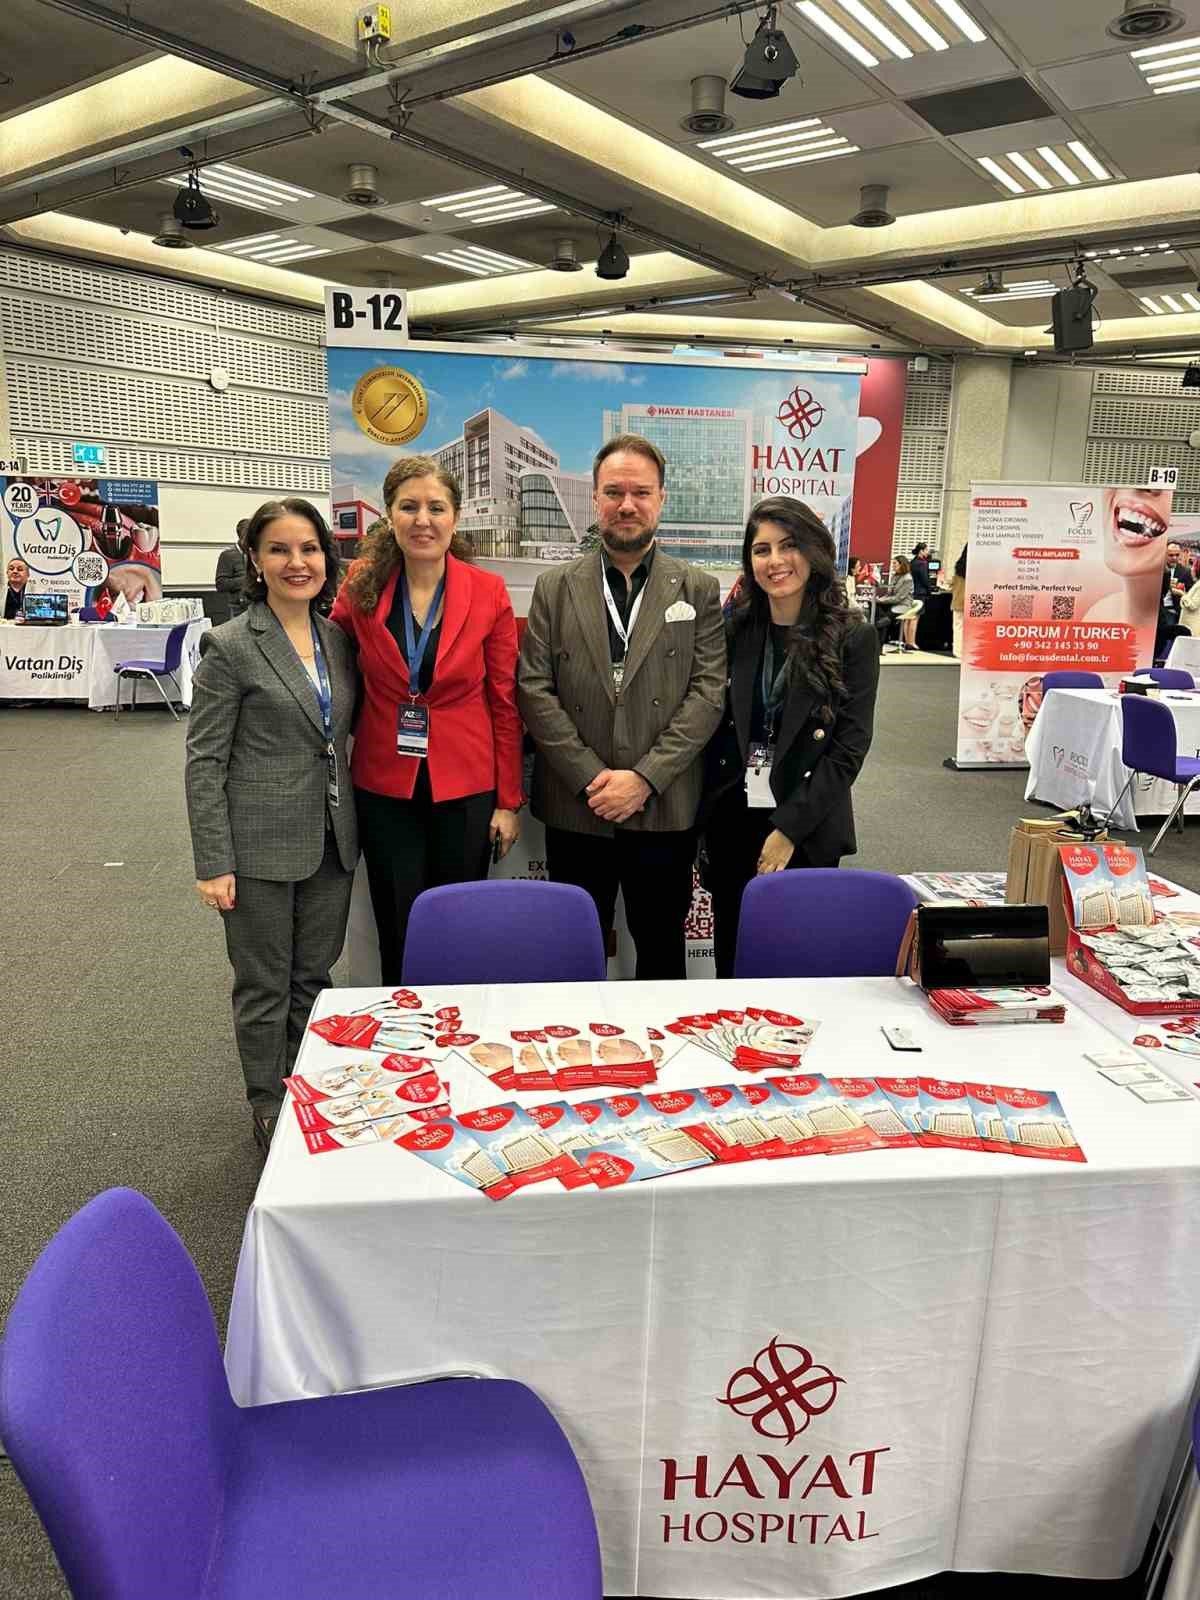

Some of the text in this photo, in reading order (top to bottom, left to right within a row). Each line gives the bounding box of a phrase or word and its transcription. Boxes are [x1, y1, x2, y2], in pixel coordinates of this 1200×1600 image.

[332, 291, 402, 331] B-12
[658, 408, 685, 416] HAYAT
[0, 461, 19, 471] C-14
[752, 445, 845, 473] HAYAT
[1151, 469, 1176, 484] B-19
[11, 487, 31, 502] 20
[752, 477, 841, 497] HOSPITAL
[23, 543, 77, 557] Vatan Diş
[996, 625, 1131, 640] BODRUM / TURKEY
[1013, 641, 1032, 649] +90
[1034, 641, 1051, 649] 542
[1087, 642, 1099, 650] 90
[5, 656, 84, 674] Vatan Diş
[1000, 652, 1111, 664] info@focusdental.com.tr
[928, 1084, 961, 1096] HAYAT
[660, 1447, 890, 1500] HAYAT
[660, 1510, 880, 1544] HOSPITAL
